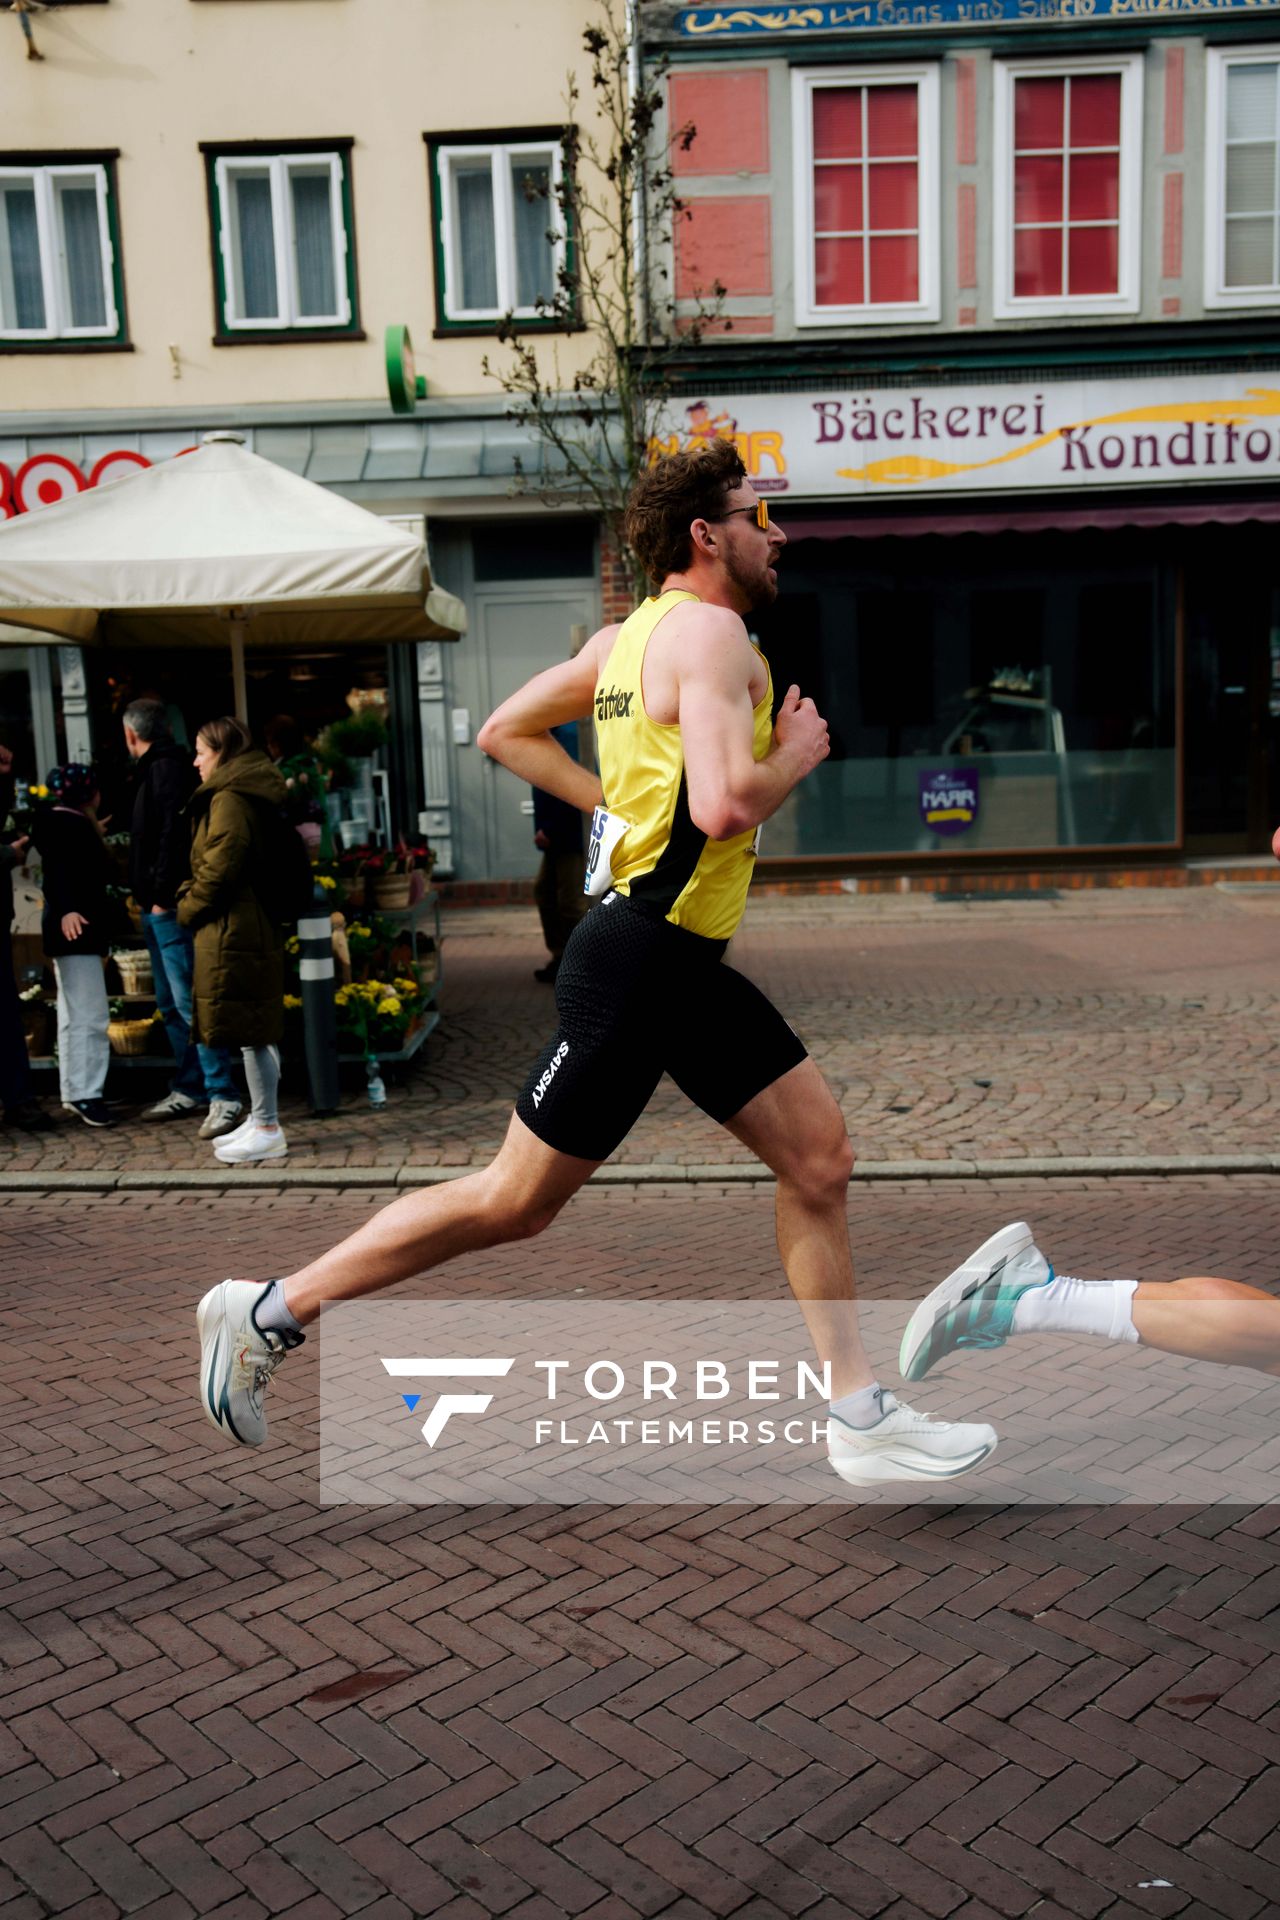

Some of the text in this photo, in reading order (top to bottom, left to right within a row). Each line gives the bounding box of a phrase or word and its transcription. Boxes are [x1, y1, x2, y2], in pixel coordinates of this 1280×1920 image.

[812, 395, 1045, 444] Bäckerei
[1059, 419, 1280, 471] Kondito
[532, 1041, 569, 1109] SAYSKY
